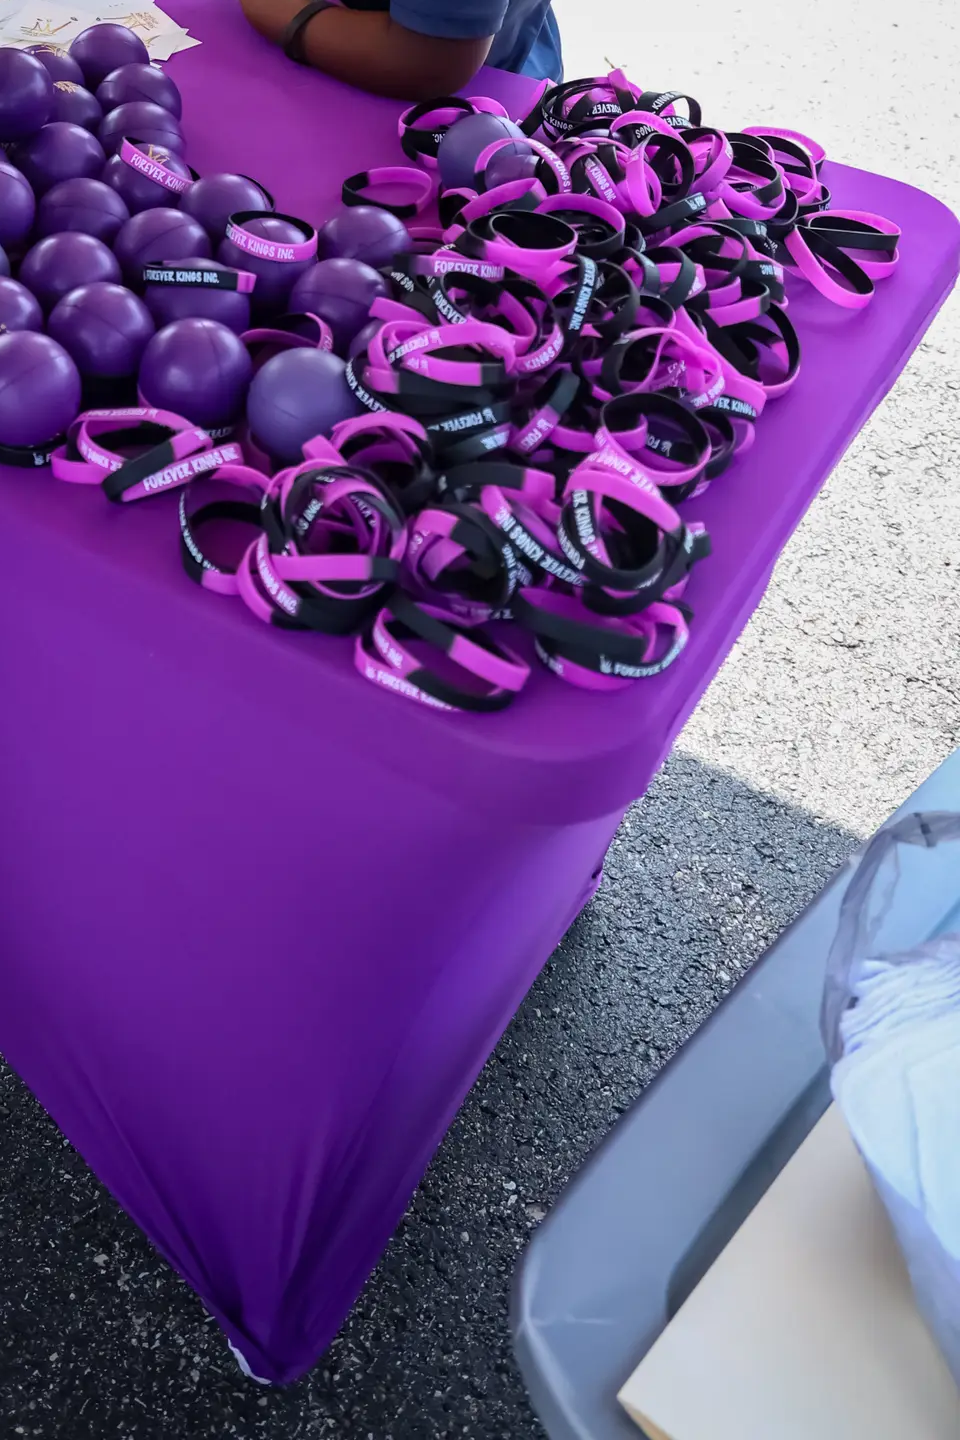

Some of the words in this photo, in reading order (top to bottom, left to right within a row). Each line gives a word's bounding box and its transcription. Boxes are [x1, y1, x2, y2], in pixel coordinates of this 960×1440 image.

[130, 153, 168, 182] FOREVER
[164, 175, 186, 192] KING
[590, 164, 609, 193] KINGS
[247, 238, 275, 258] KINGS
[277, 247, 295, 260] INC.
[146, 268, 175, 282] FOREVER
[176, 271, 202, 283] KINGS
[203, 272, 220, 284] INC.
[432, 290, 468, 325] FOREVER
[573, 286, 593, 315] KINGS
[142, 463, 192, 491] FOREVER
[191, 451, 224, 473] KINGS
[509, 525, 543, 562] KINGS
[574, 509, 596, 546] KINGS
